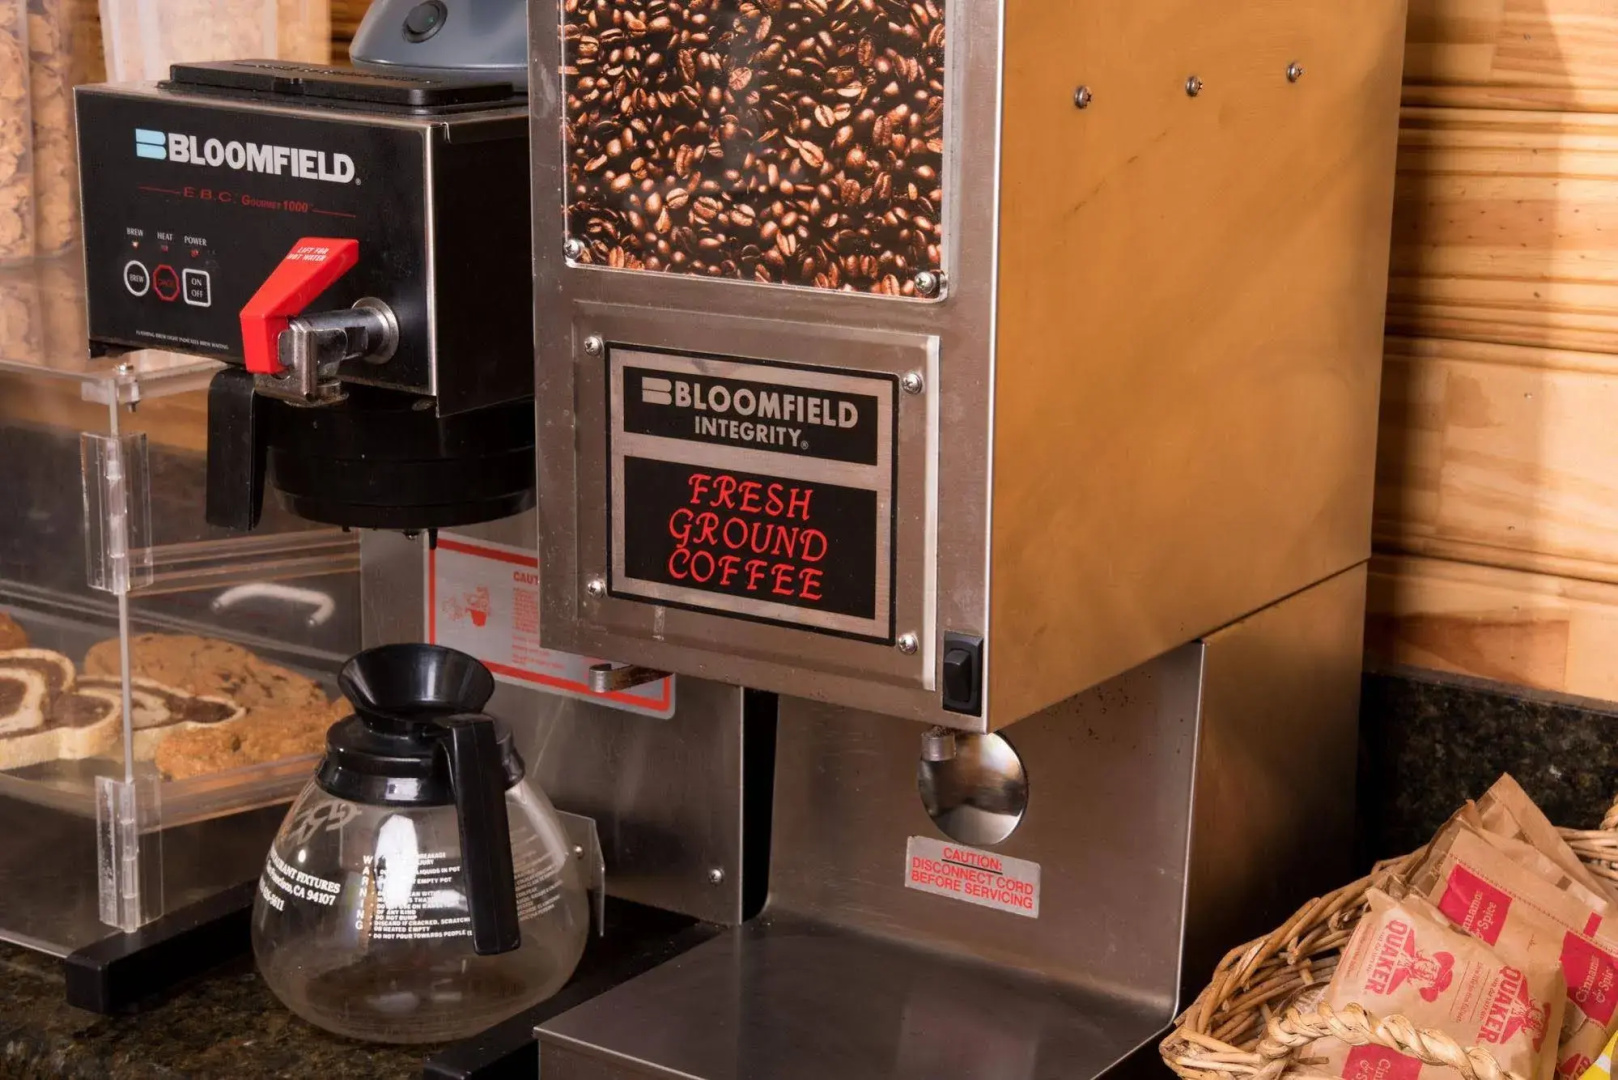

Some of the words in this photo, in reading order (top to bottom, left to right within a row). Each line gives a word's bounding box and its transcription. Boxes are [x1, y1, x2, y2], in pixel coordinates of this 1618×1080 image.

[168, 132, 356, 184] BLOOMFIELD
[283, 200, 308, 213] 1000
[126, 227, 144, 237] BREW
[157, 231, 173, 241] HEAT
[184, 235, 207, 246] POWER
[129, 273, 144, 283] BREW
[191, 277, 202, 286] ON
[191, 289, 203, 298] OFF
[675, 380, 859, 429] BLOOMFIELD
[695, 415, 802, 448] INTEGRITY
[688, 472, 813, 521] FRESH
[668, 507, 828, 562] GROUND
[668, 547, 824, 601] COFFEE
[943, 846, 1003, 871] CAUTION:
[296, 871, 341, 894] FIXTURES
[911, 870, 961, 891] BEFORE
[964, 882, 1033, 909] SERVICING
[912, 856, 994, 885] DISCONNECT
[996, 876, 1034, 895] CORD
[293, 884, 305, 898] CA
[306, 889, 336, 906] 94107
[355, 855, 373, 930] WARNING
[1477, 901, 1497, 930] Spice
[1364, 919, 1408, 995] QUAKER
[1477, 965, 1522, 1044] QUAKER
